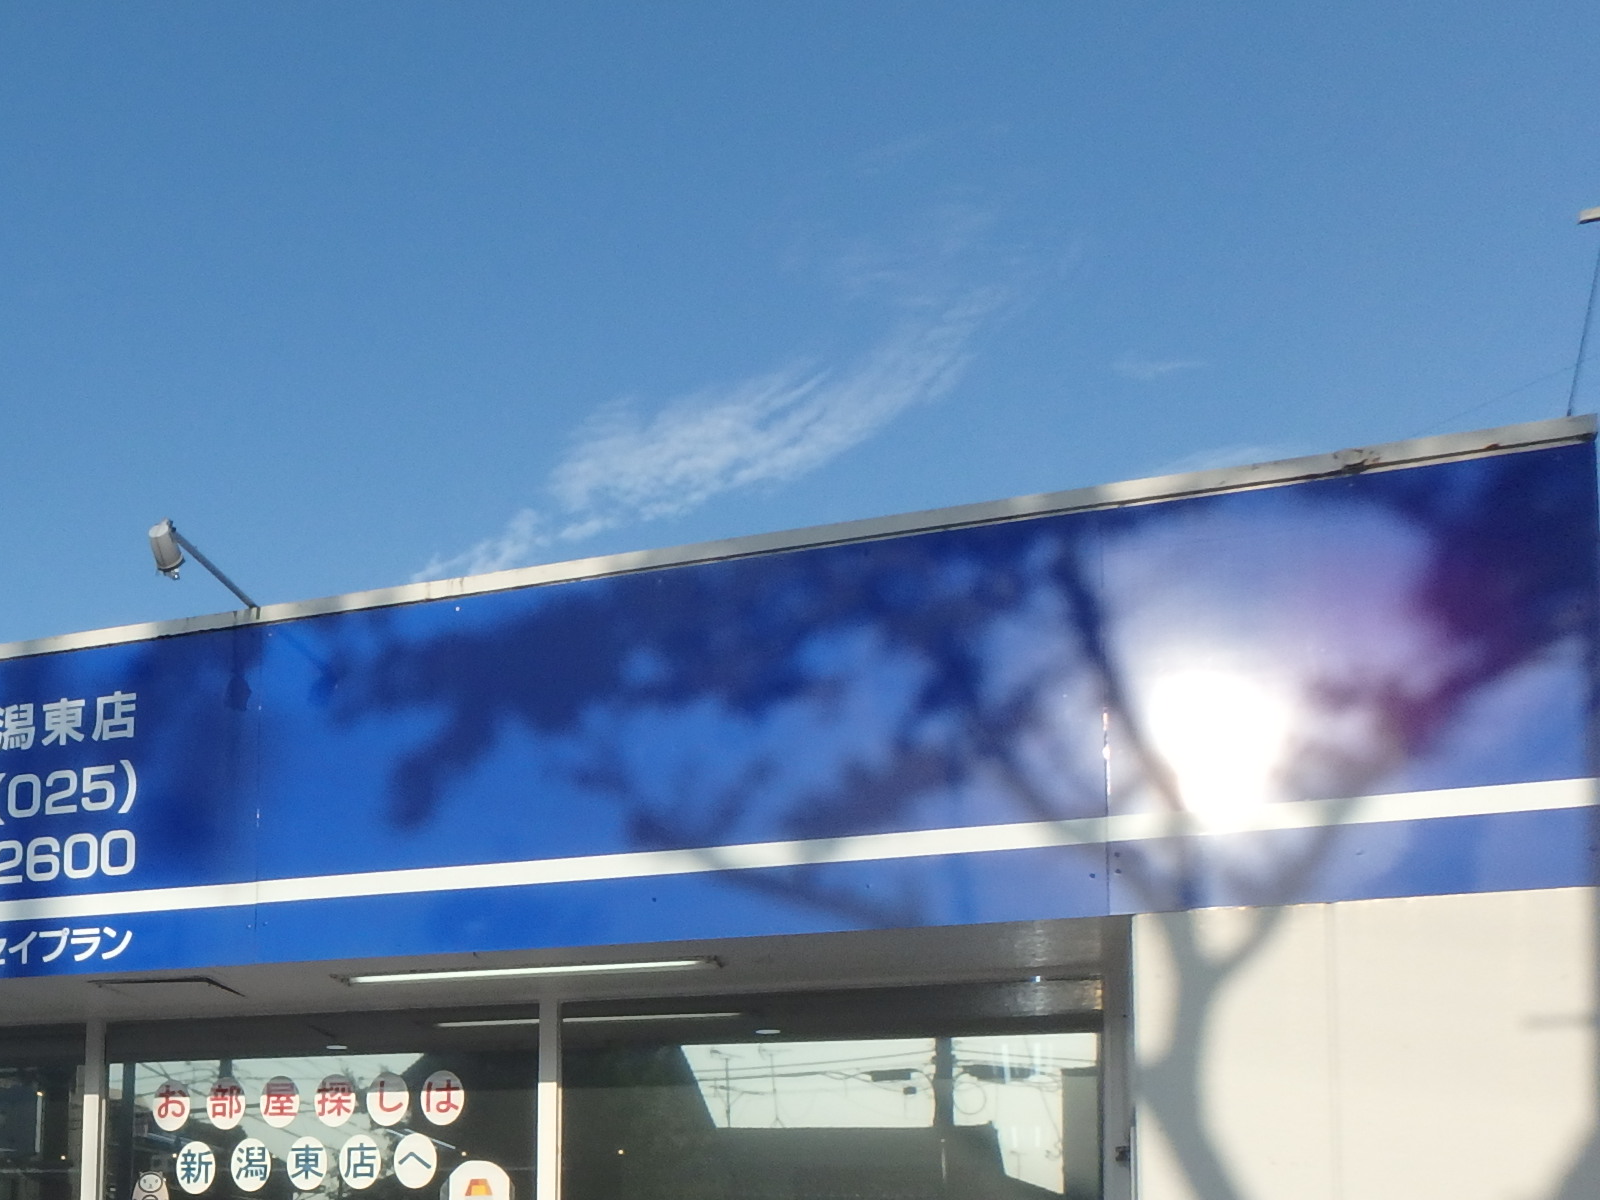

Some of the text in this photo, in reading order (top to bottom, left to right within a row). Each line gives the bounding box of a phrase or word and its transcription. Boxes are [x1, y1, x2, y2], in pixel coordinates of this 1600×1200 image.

[156, 1079, 462, 1120] お部屋探しは
[180, 1142, 432, 1186] 新潟東店へ
